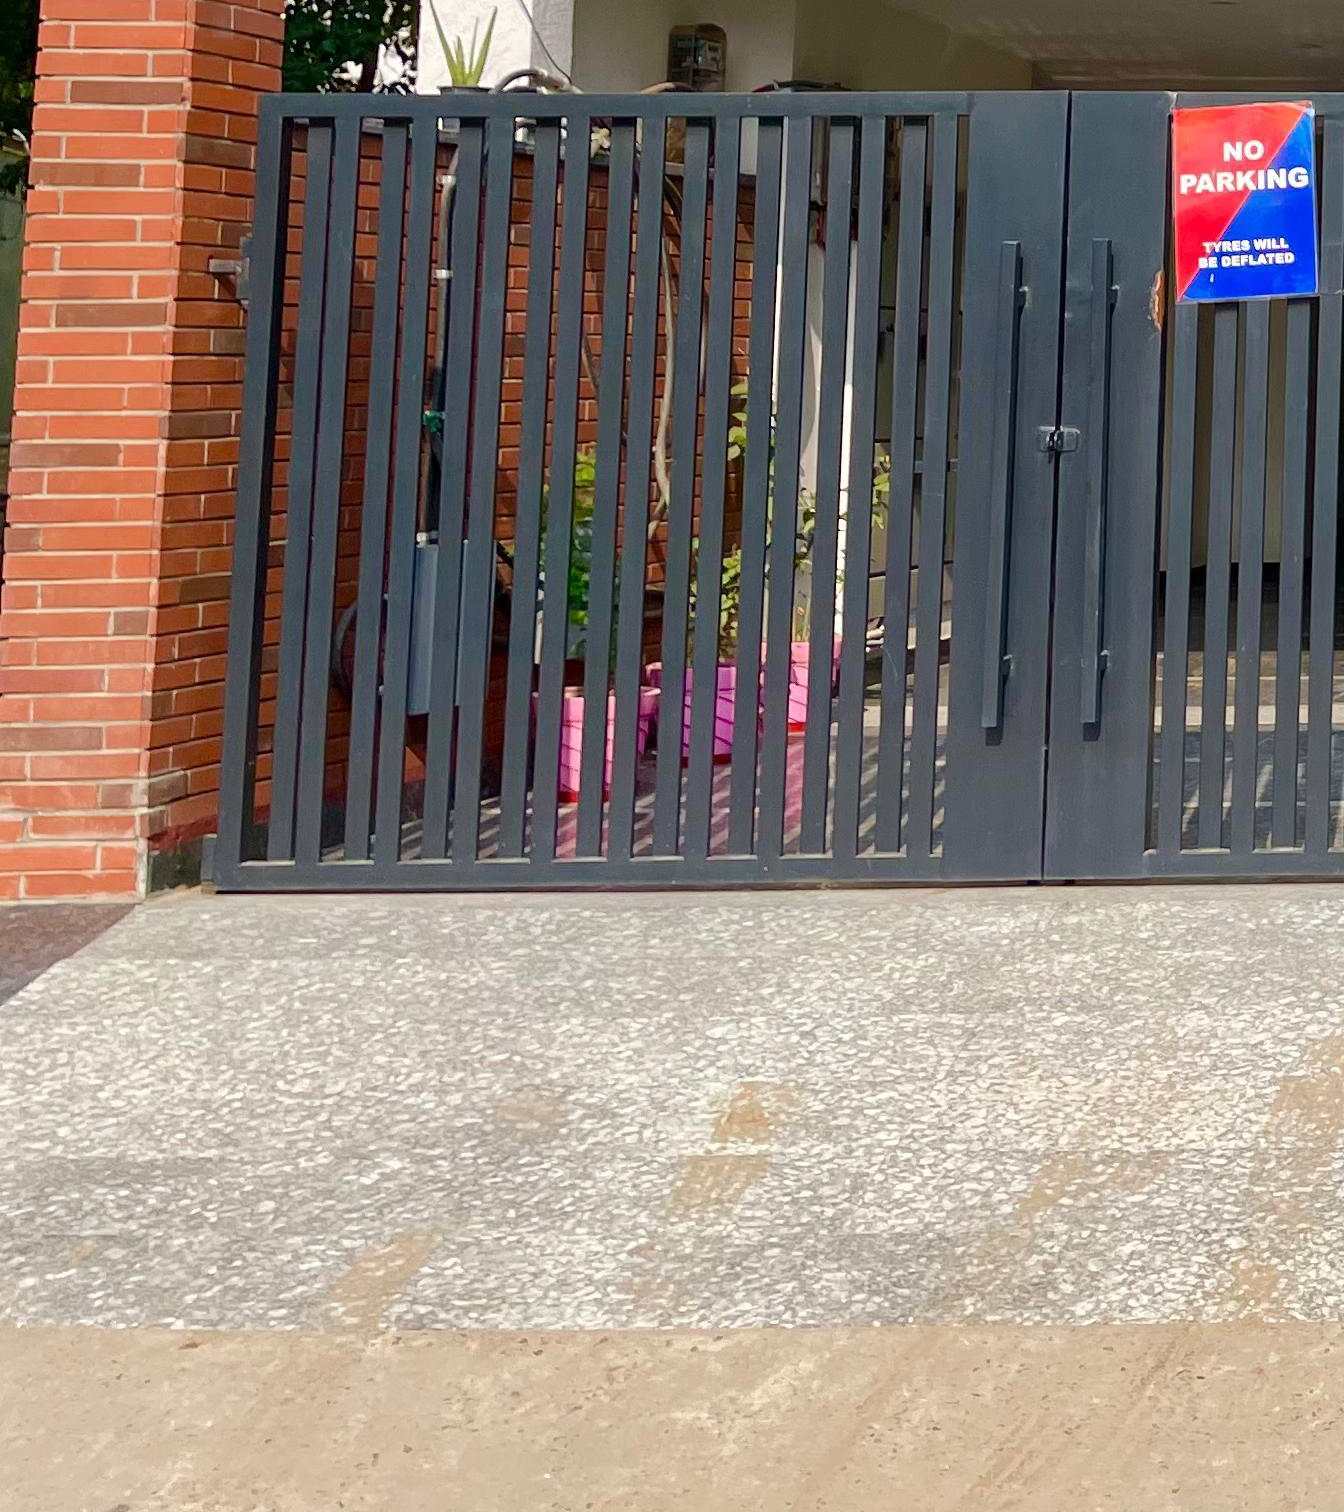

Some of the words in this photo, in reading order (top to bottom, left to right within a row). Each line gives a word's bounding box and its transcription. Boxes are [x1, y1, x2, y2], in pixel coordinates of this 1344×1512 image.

[1223, 139, 1265, 163] NO
[1179, 166, 1309, 195] PARKING
[1203, 239, 1251, 254] TYRES
[1253, 237, 1289, 251] WILL
[1198, 256, 1218, 269] BE
[1221, 251, 1295, 268] DEFLATED
